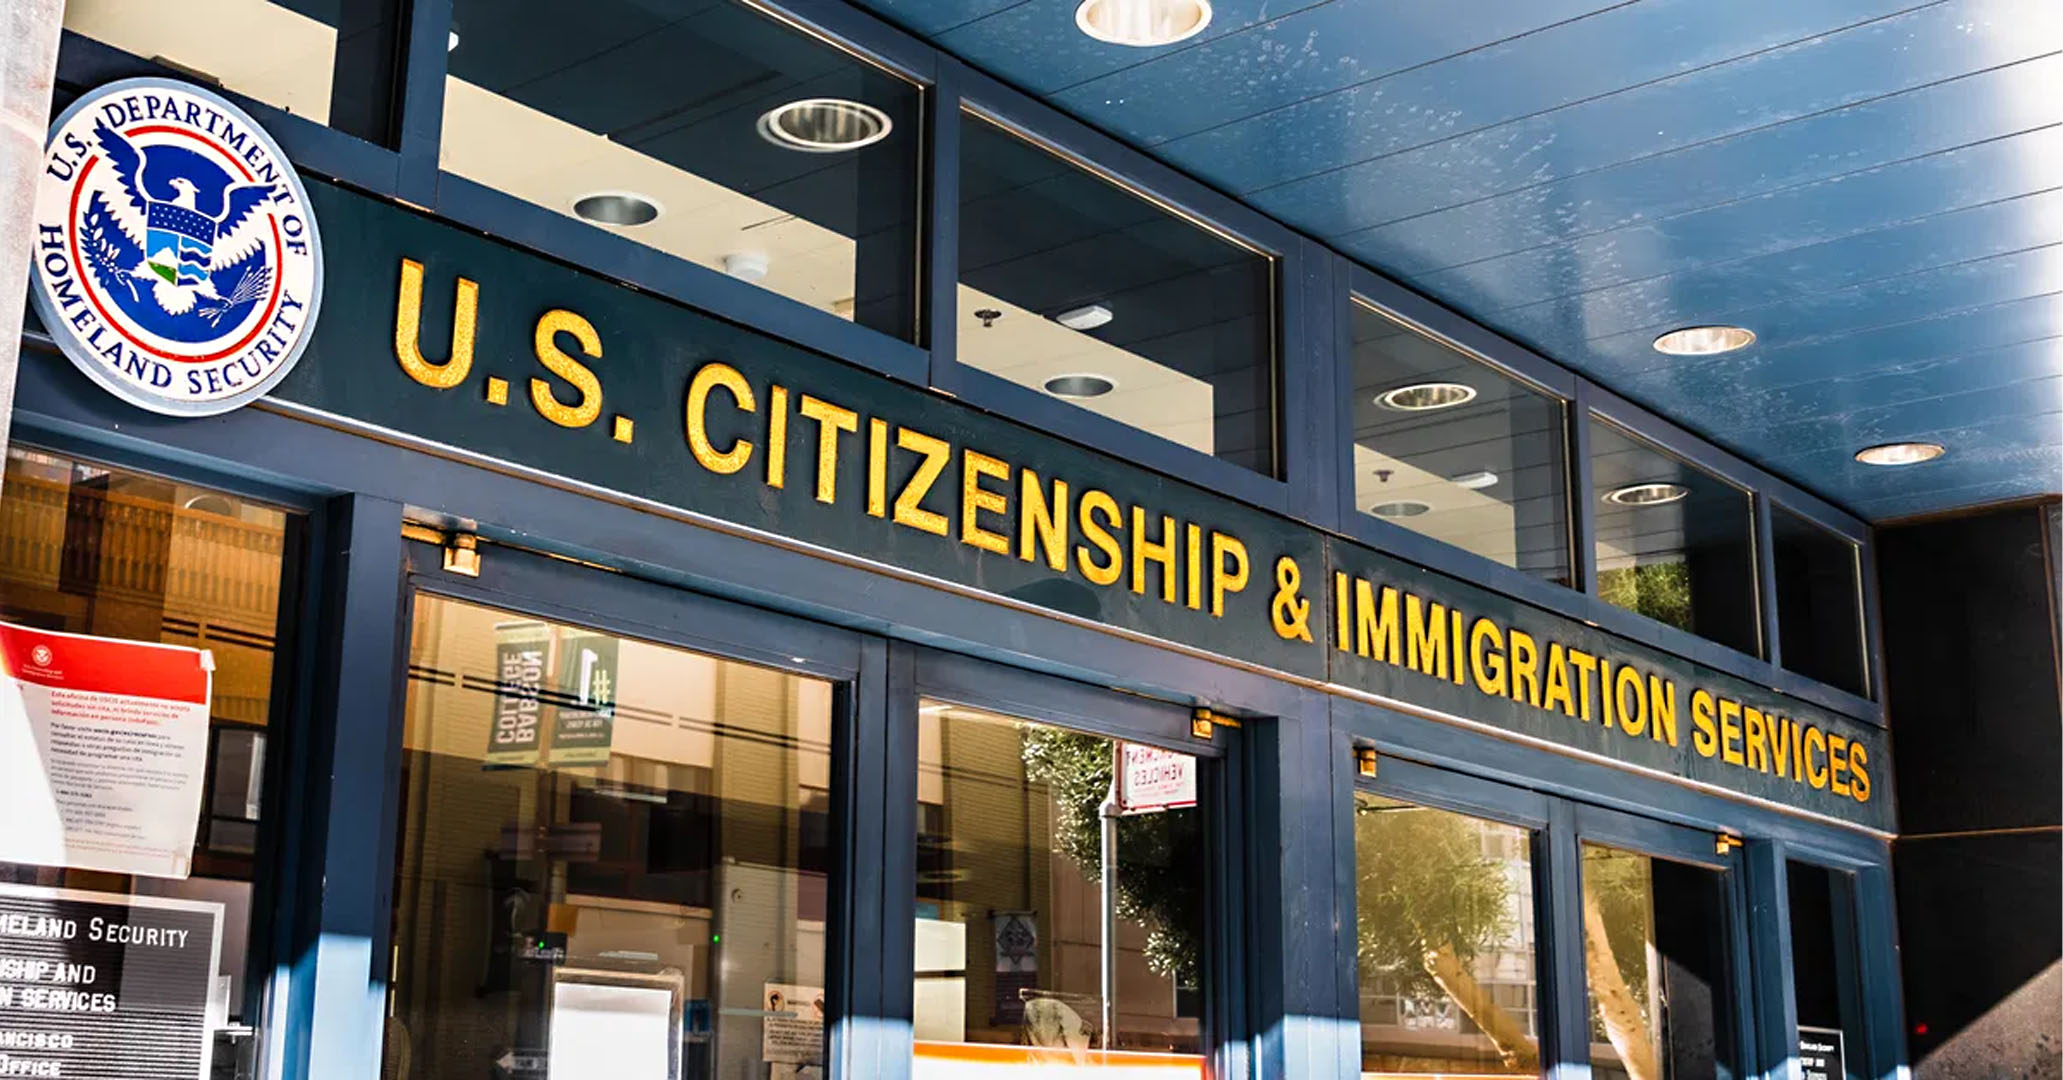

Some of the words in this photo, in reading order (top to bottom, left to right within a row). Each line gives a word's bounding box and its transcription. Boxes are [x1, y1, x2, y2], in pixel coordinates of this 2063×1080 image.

[47, 132, 92, 182] U.S.
[102, 95, 295, 207] DEPARTMENT
[283, 216, 307, 257] OF
[39, 223, 172, 388] HOMELAND
[187, 290, 303, 395] SECURITY
[395, 257, 634, 444] U.S.
[686, 362, 1250, 618] CITIZENSHIP
[1271, 556, 1314, 643] &
[1335, 570, 1678, 747] IMMIGRATION
[1690, 688, 1872, 802] SERVICES
[52, 962, 96, 984] AND
[88, 917, 189, 948] SECURITY
[21, 987, 116, 1013] SERVICES
